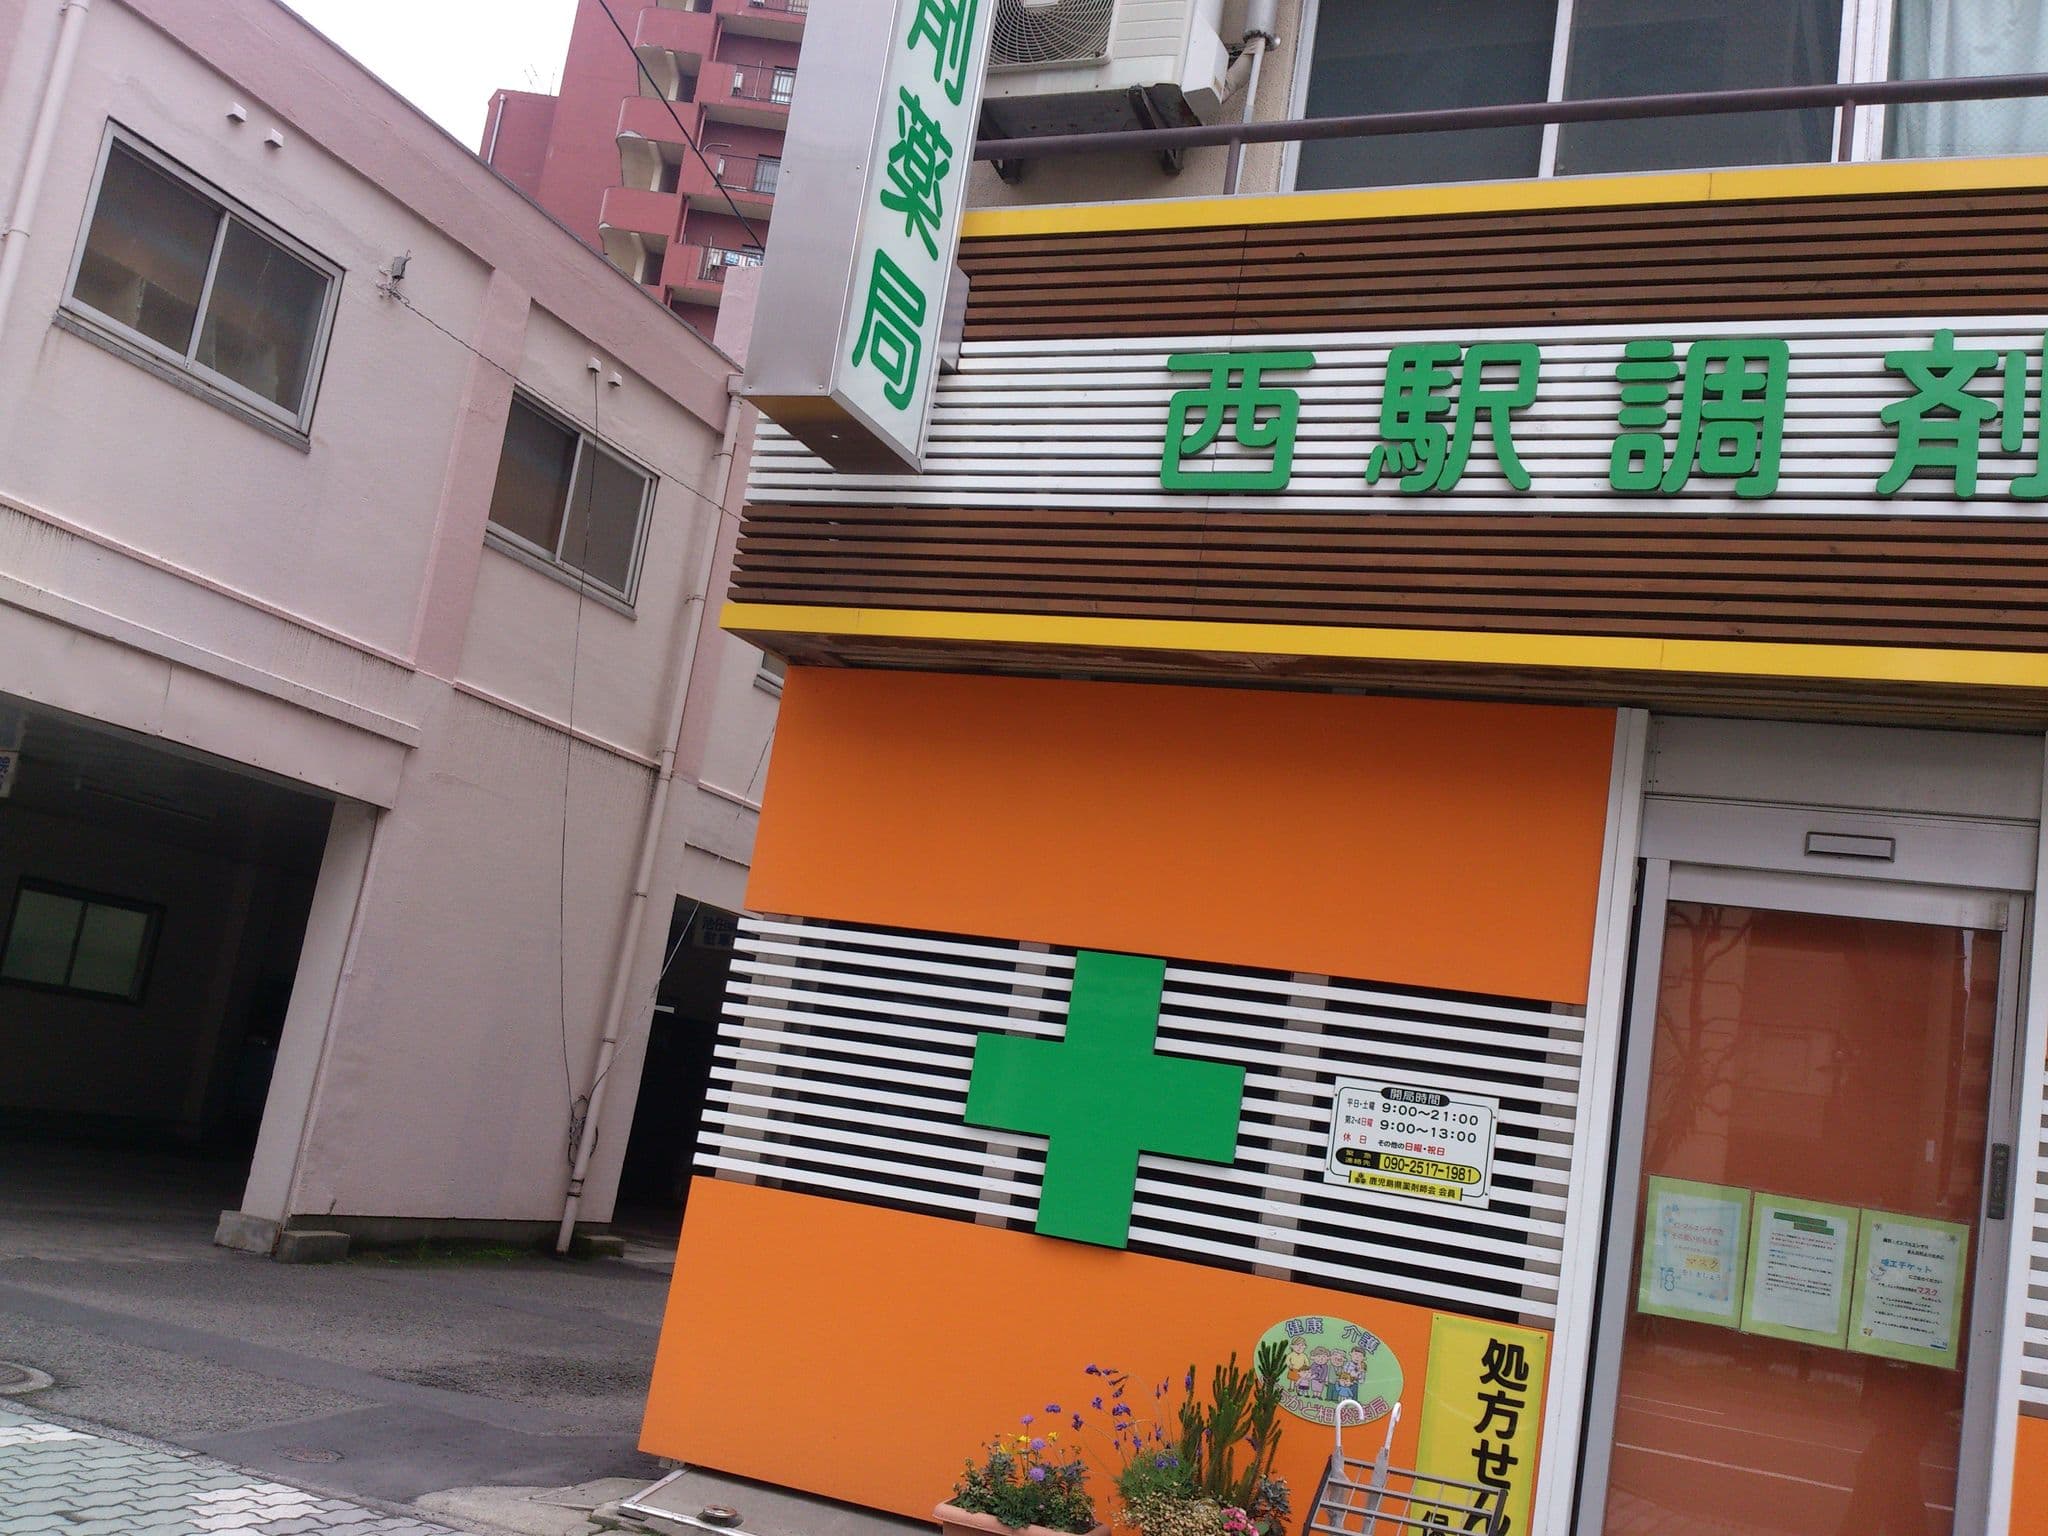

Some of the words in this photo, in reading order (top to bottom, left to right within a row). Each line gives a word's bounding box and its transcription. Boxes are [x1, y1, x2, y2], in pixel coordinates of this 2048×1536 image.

[1389, 1088, 1441, 1106] 開局時間
[1383, 1155, 1473, 1183] 090-2517-1981
[1285, 1317, 1324, 1338] 健康
[1341, 1324, 1381, 1355] 介護
